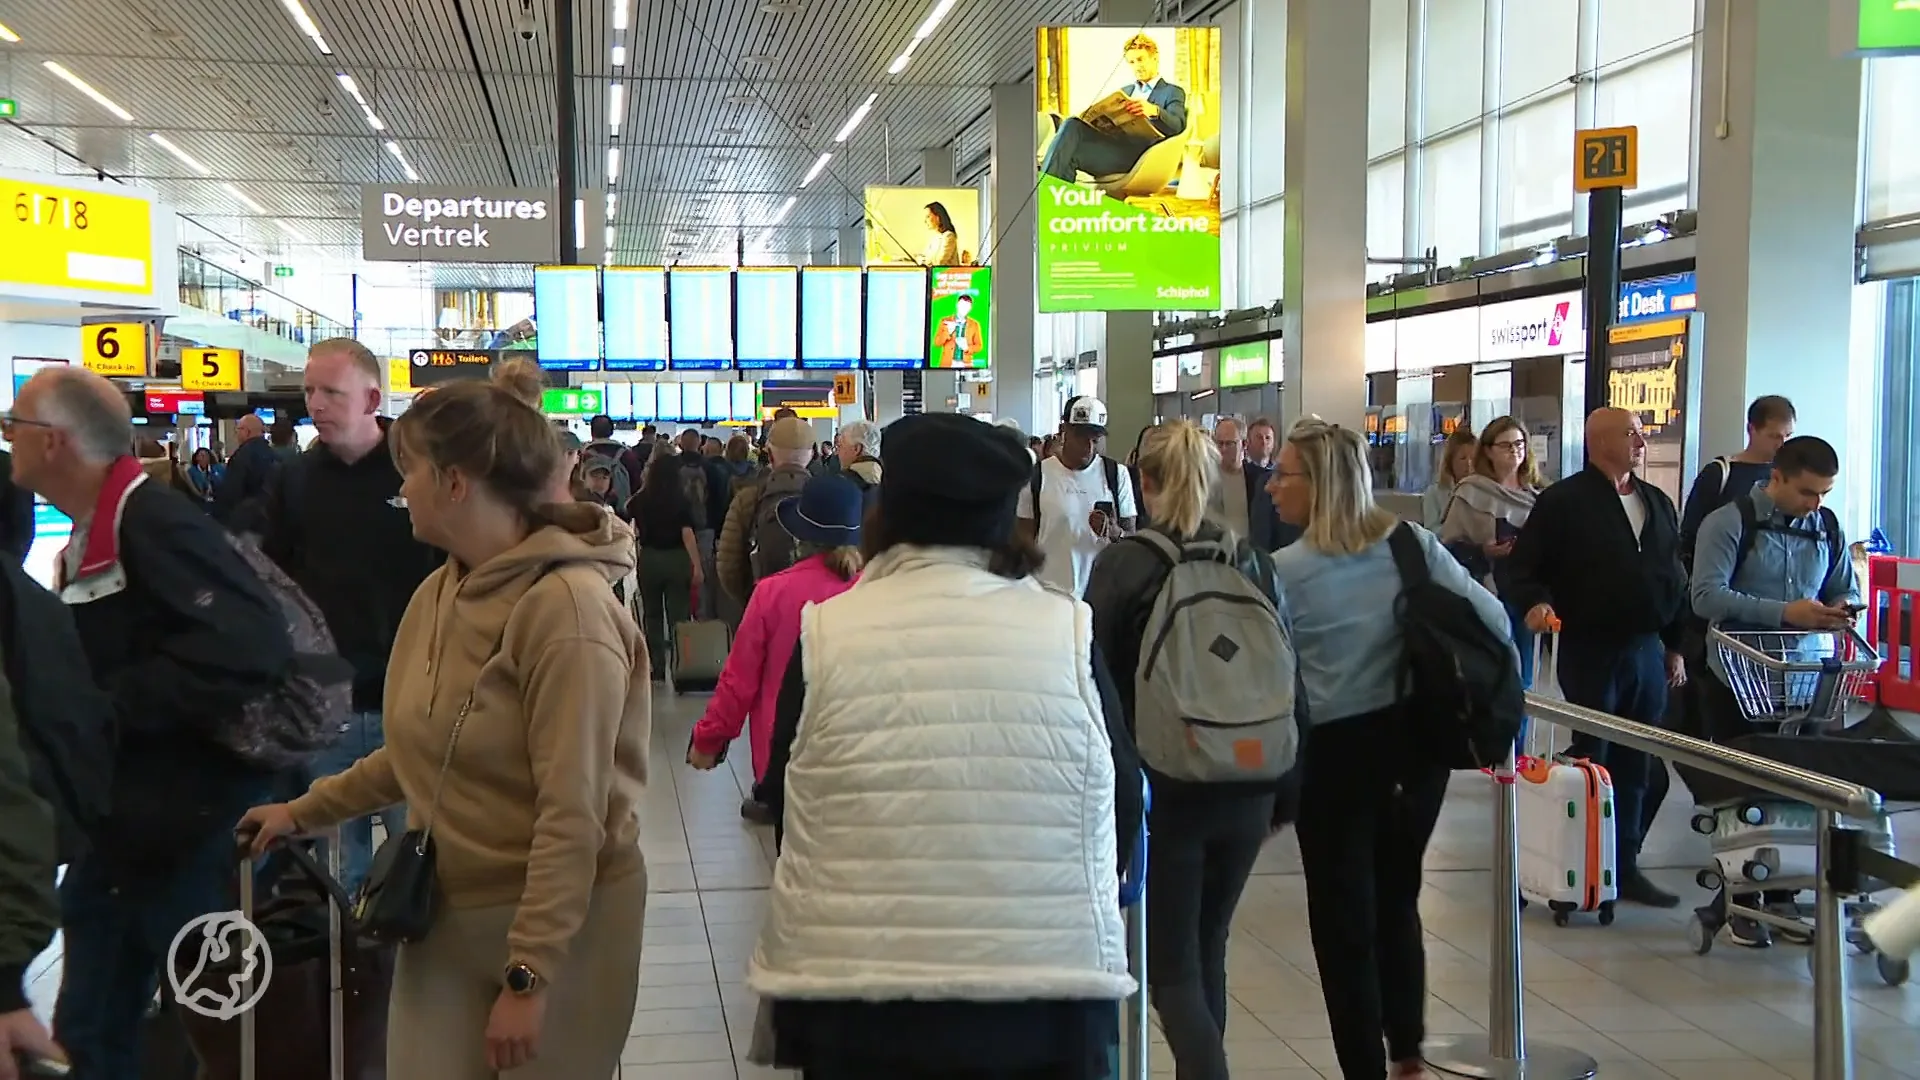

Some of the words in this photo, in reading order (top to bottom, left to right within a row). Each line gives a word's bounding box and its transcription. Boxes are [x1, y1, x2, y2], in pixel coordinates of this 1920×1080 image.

[383, 192, 547, 222] Departures
[1049, 185, 1107, 206] Your
[382, 222, 490, 248] Vertrek
[1049, 211, 1147, 234] comfort
[1151, 216, 1209, 233] zone
[1050, 243, 1127, 252] PRIVIUM
[1156, 286, 1210, 299] Schiphol
[1631, 287, 1666, 316] Desk
[96, 327, 120, 359] 6
[1491, 317, 1547, 349] swissport
[202, 352, 219, 378] 5
[457, 354, 489, 364] Toilets
